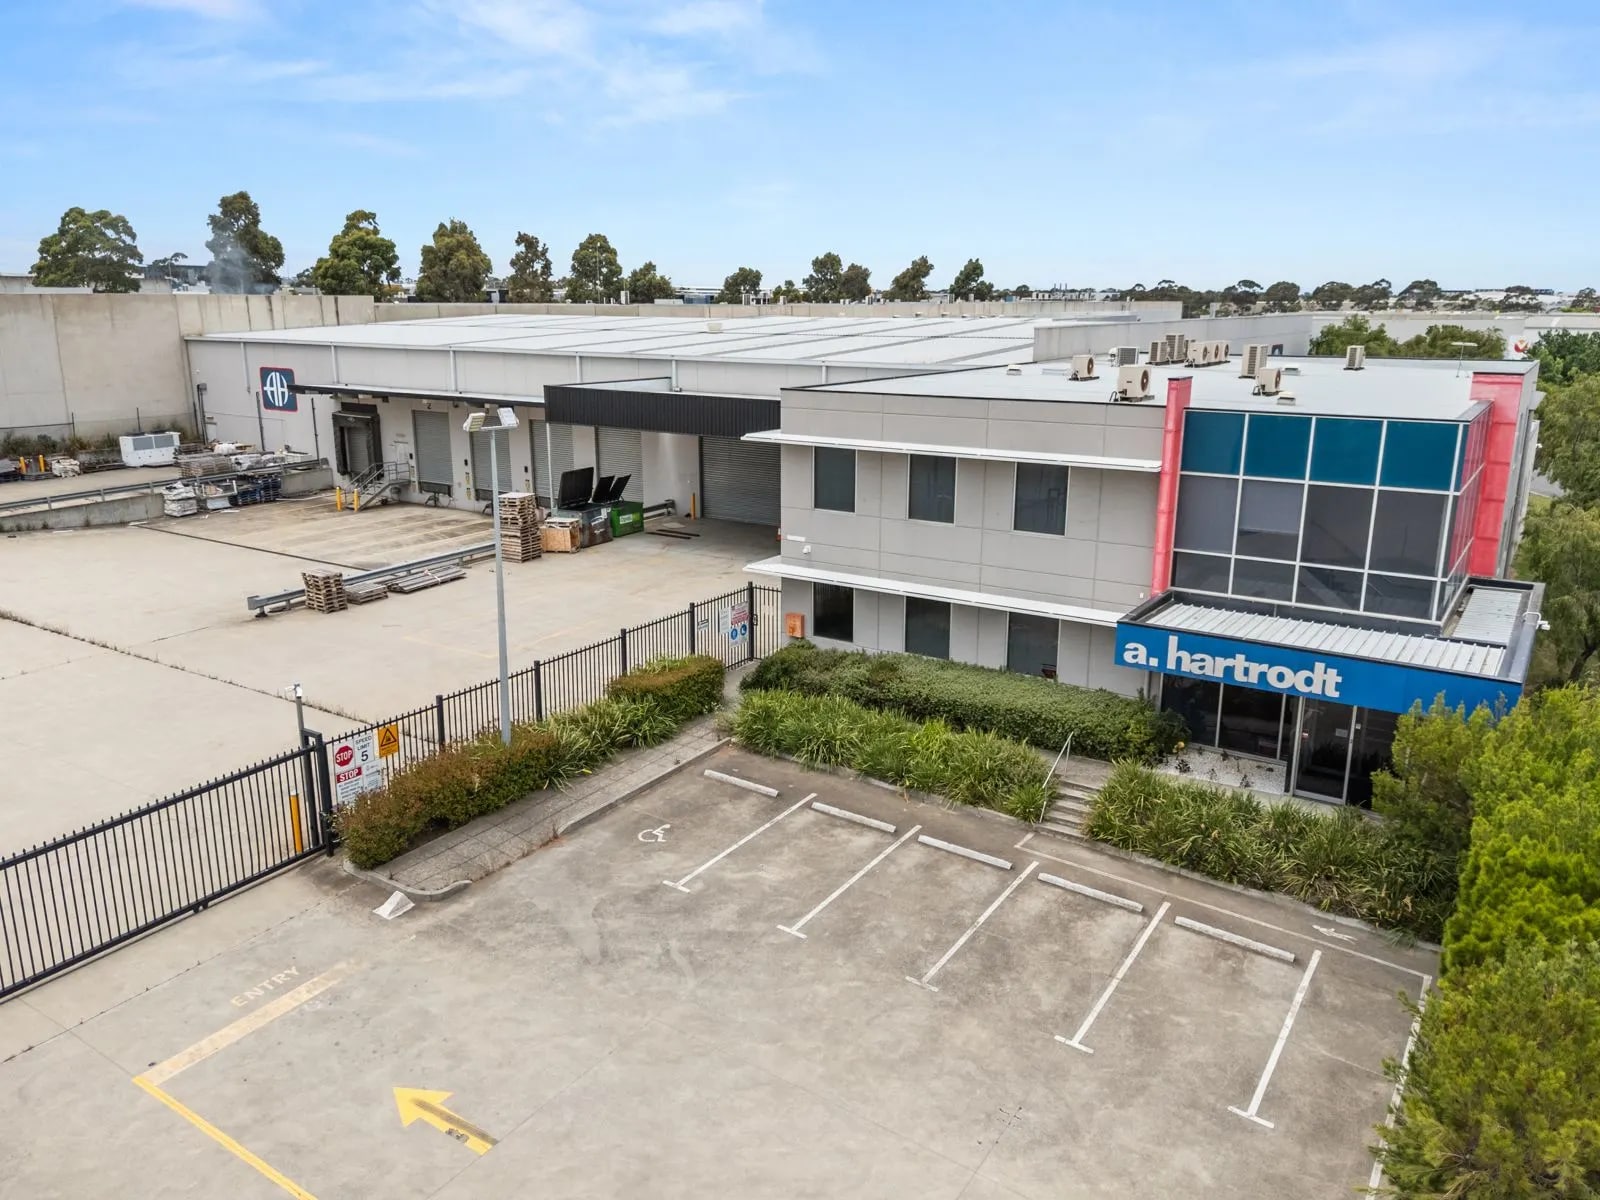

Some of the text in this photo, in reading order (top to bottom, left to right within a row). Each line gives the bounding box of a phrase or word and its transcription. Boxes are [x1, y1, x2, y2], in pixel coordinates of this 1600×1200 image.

[1122, 635, 1342, 697] a. hartrodt
[355, 735, 372, 744] SPEED
[357, 742, 370, 751] LIMIT
[335, 750, 353, 763] STOP
[361, 750, 369, 762] 5
[339, 768, 359, 782] STOP
[231, 966, 299, 1007] ENTRY
